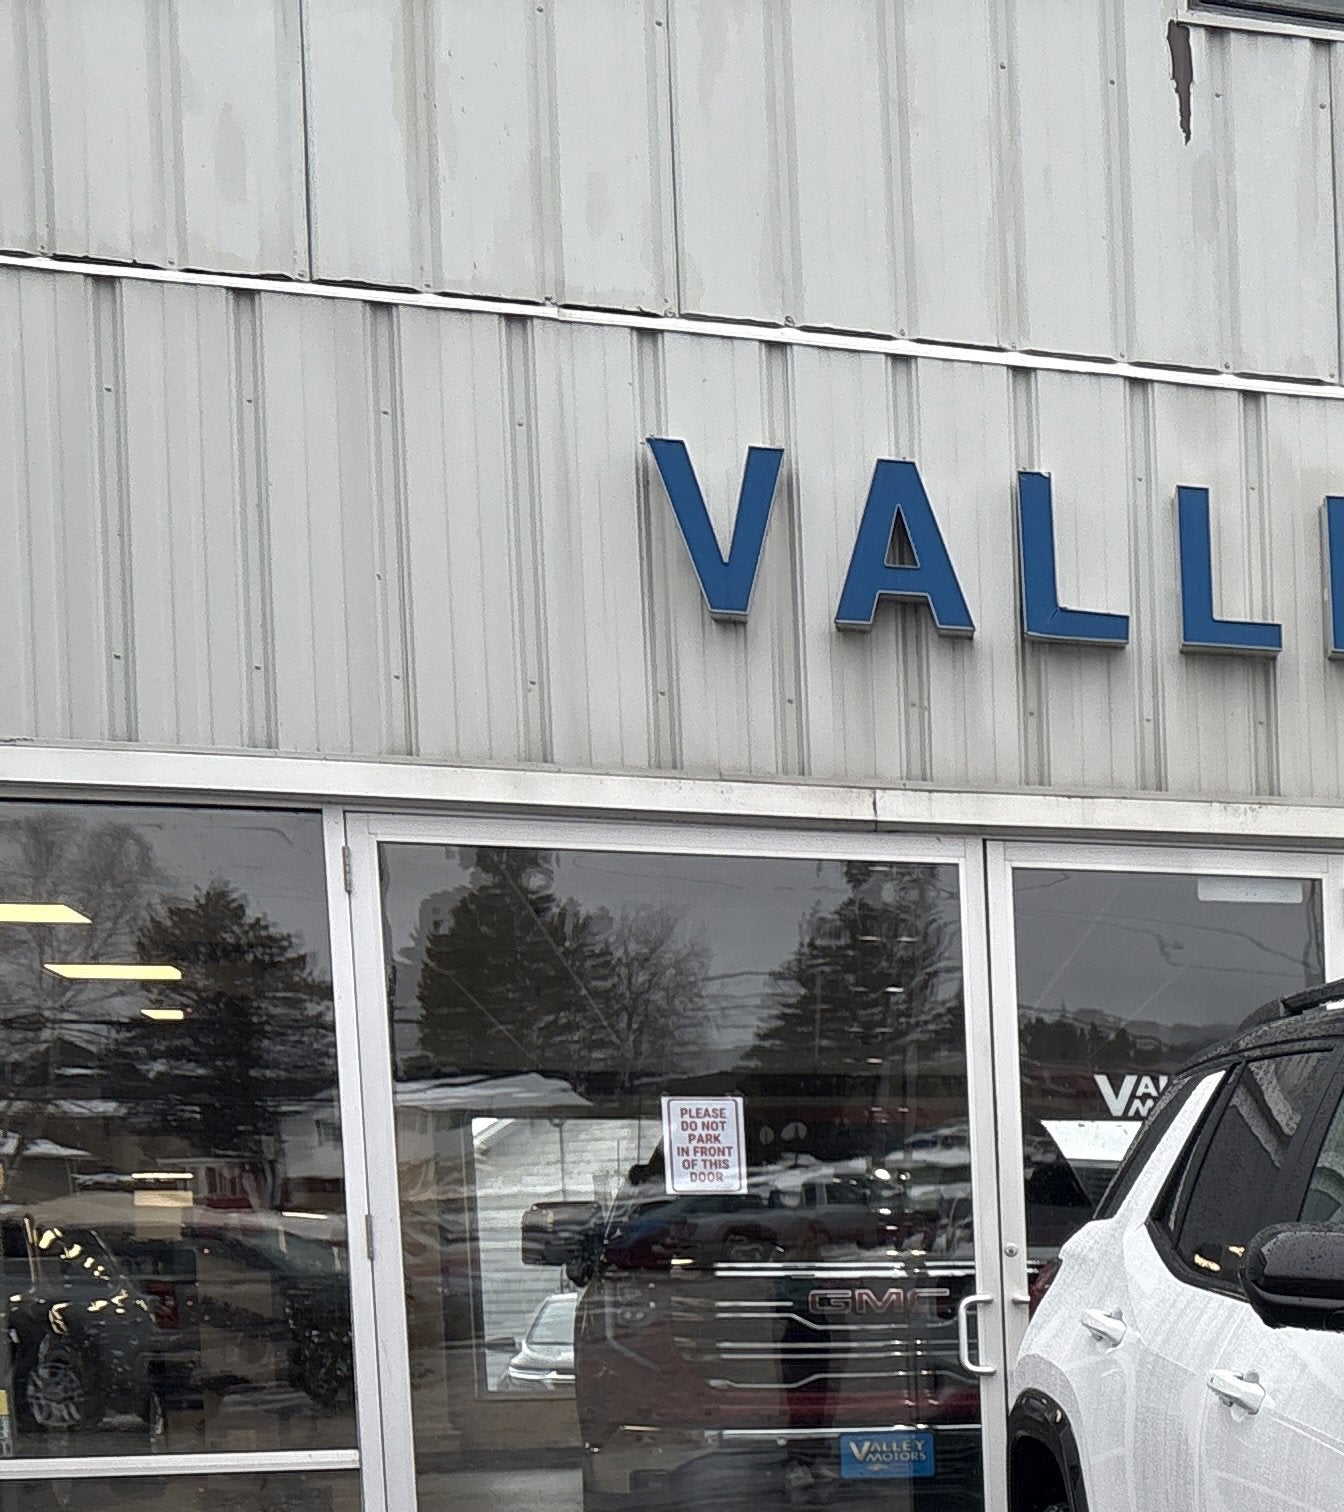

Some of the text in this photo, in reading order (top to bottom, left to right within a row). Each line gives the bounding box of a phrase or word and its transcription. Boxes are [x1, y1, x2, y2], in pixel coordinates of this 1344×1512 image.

[679, 1107, 727, 1119] PLEASE
[681, 1120, 726, 1132] DO NOT
[688, 1133, 721, 1144] PARK
[677, 1146, 734, 1157] IN FRONT
[682, 1158, 730, 1170] OF THIS
[689, 1171, 724, 1183] DOOR
[808, 1288, 951, 1315] GMC
[848, 1439, 926, 1462] VALLEY
[865, 1449, 927, 1462] MOTORS
